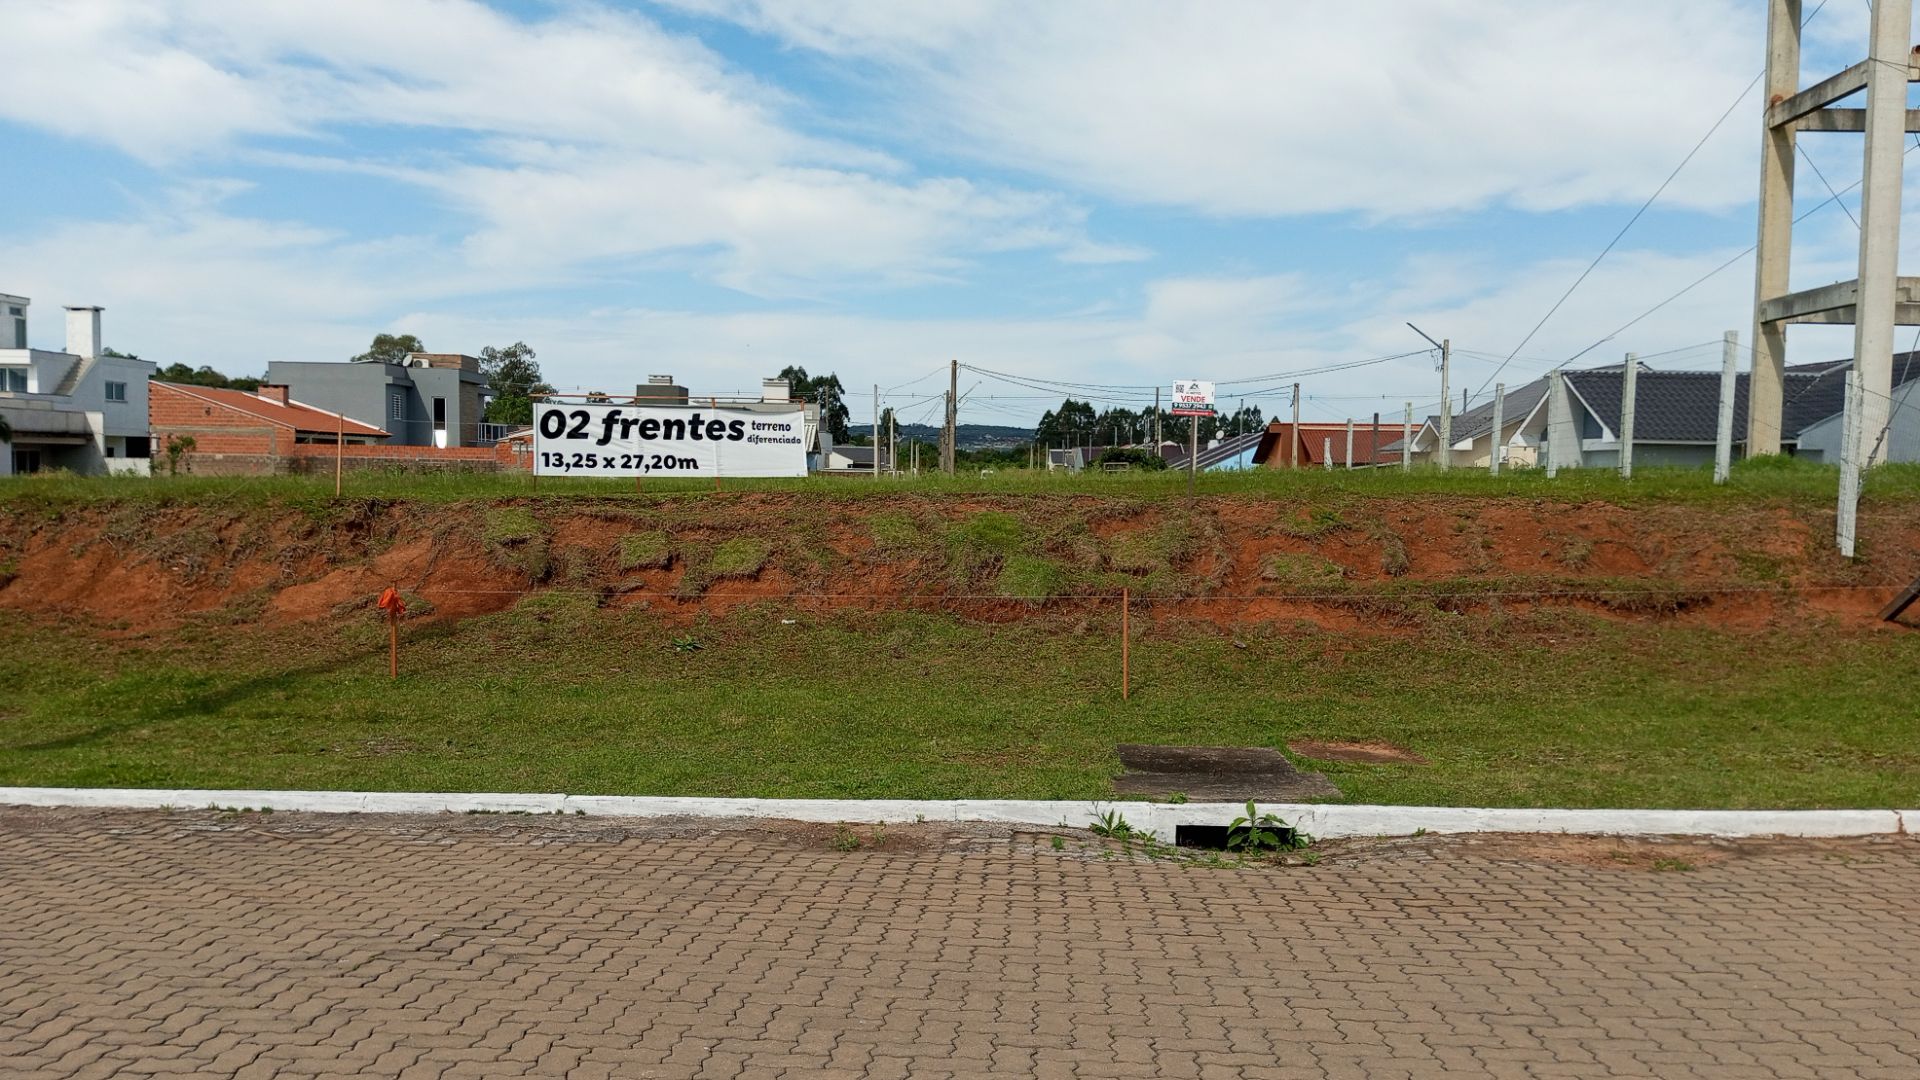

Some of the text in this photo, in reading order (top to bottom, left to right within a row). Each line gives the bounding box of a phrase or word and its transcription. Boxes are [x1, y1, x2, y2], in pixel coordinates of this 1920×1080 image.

[1181, 395, 1205, 403] VENDE
[540, 409, 745, 446] 02 frentes
[751, 421, 791, 432] terreno
[747, 434, 801, 445] diferenciado
[541, 452, 699, 473] 13,25 x 27,20m
